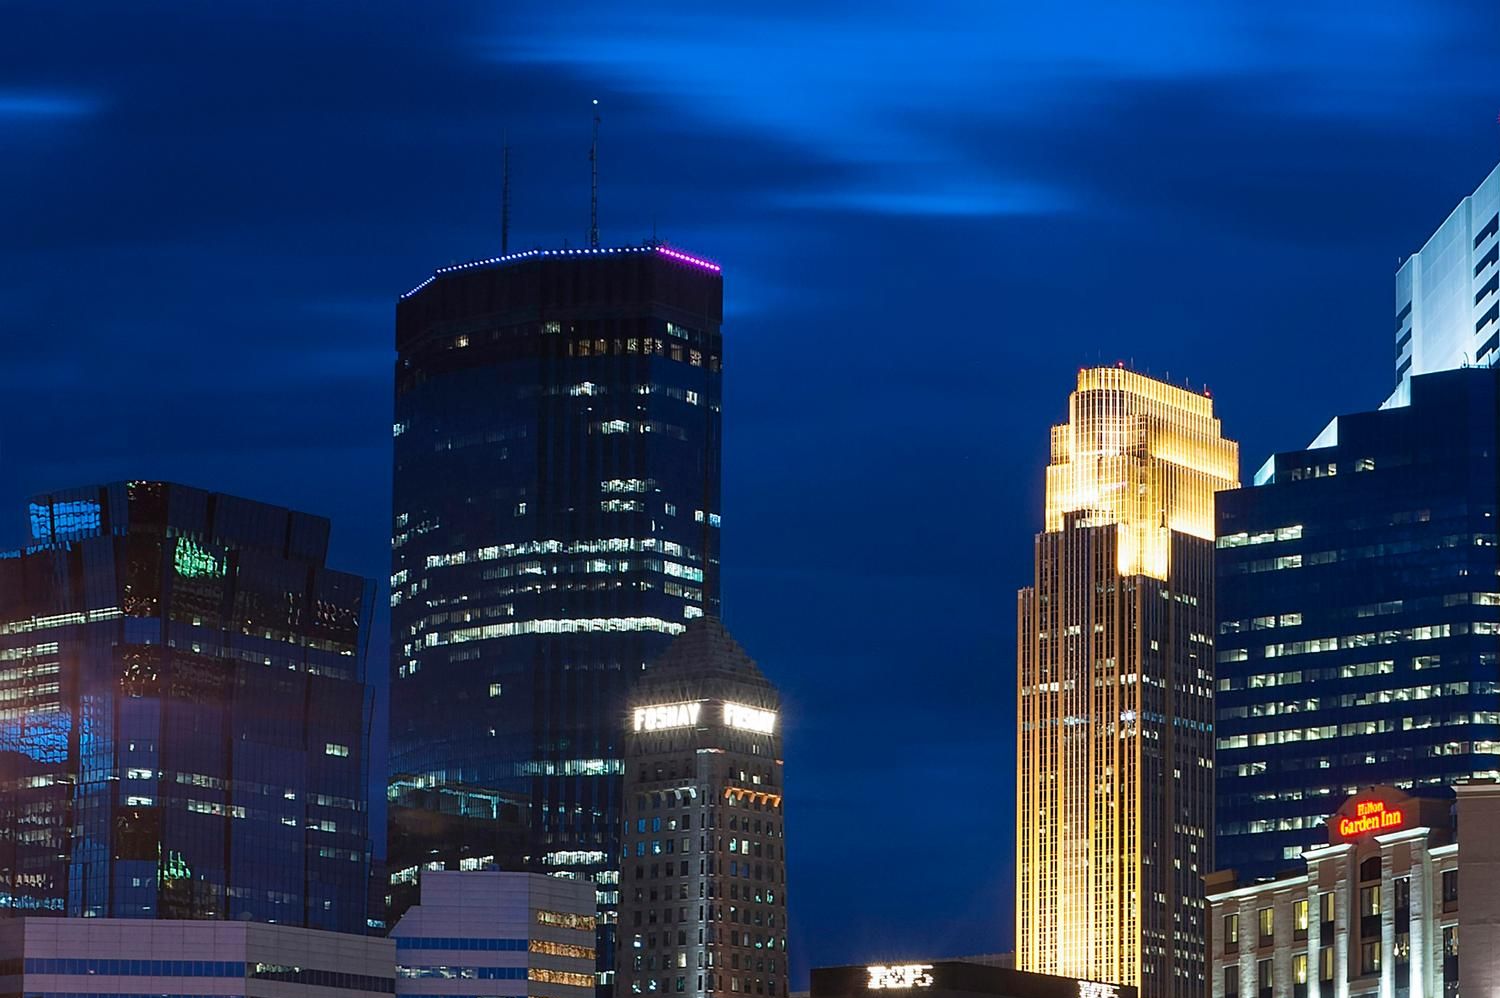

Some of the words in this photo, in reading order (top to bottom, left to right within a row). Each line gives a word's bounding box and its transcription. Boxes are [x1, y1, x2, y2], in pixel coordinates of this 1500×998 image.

[633, 702, 701, 731] FOSHAY
[1357, 800, 1384, 817] Hilton
[1340, 816, 1379, 836] Garden
[1381, 810, 1401, 828] Inn
